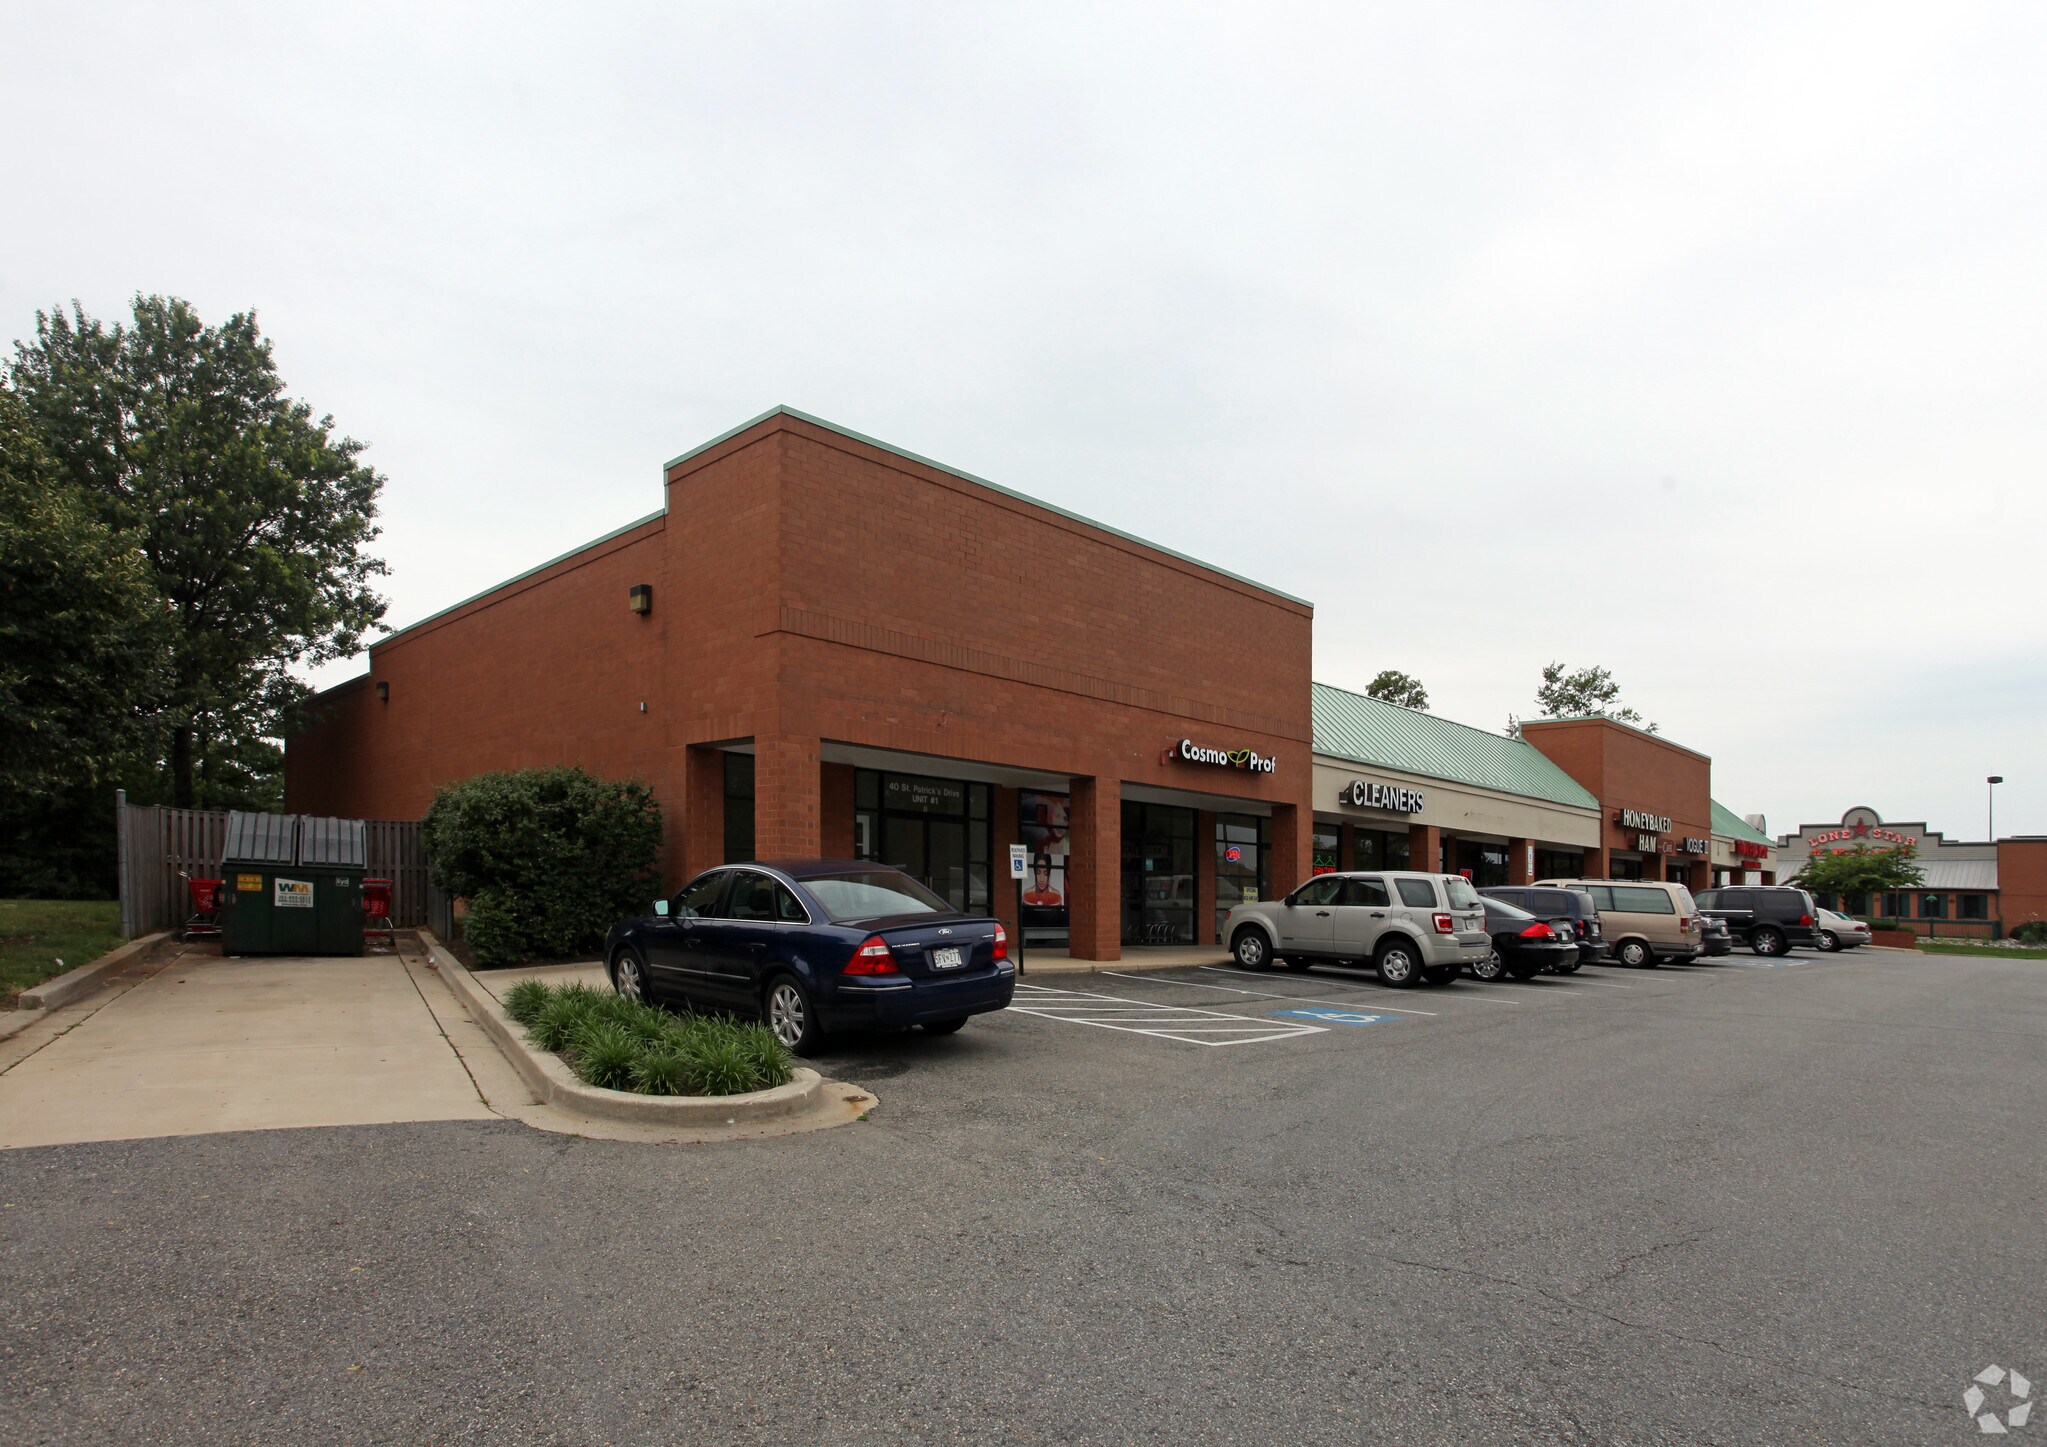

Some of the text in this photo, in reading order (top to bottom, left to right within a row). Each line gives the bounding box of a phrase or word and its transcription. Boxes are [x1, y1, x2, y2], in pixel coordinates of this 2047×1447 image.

[1182, 739, 1275, 773] Cosmo Prof
[889, 782, 899, 791] 40
[913, 785, 941, 796] Patrick's
[943, 788, 960, 798] Drive
[912, 794, 928, 803] UNIT
[1353, 780, 1424, 814] CLEANERS
[1623, 808, 1672, 833] HONEYBAKED
[1639, 834, 1657, 853] HAM
[1686, 837, 1703, 854] VOGUE
[1808, 828, 1917, 847] LONE STAR
